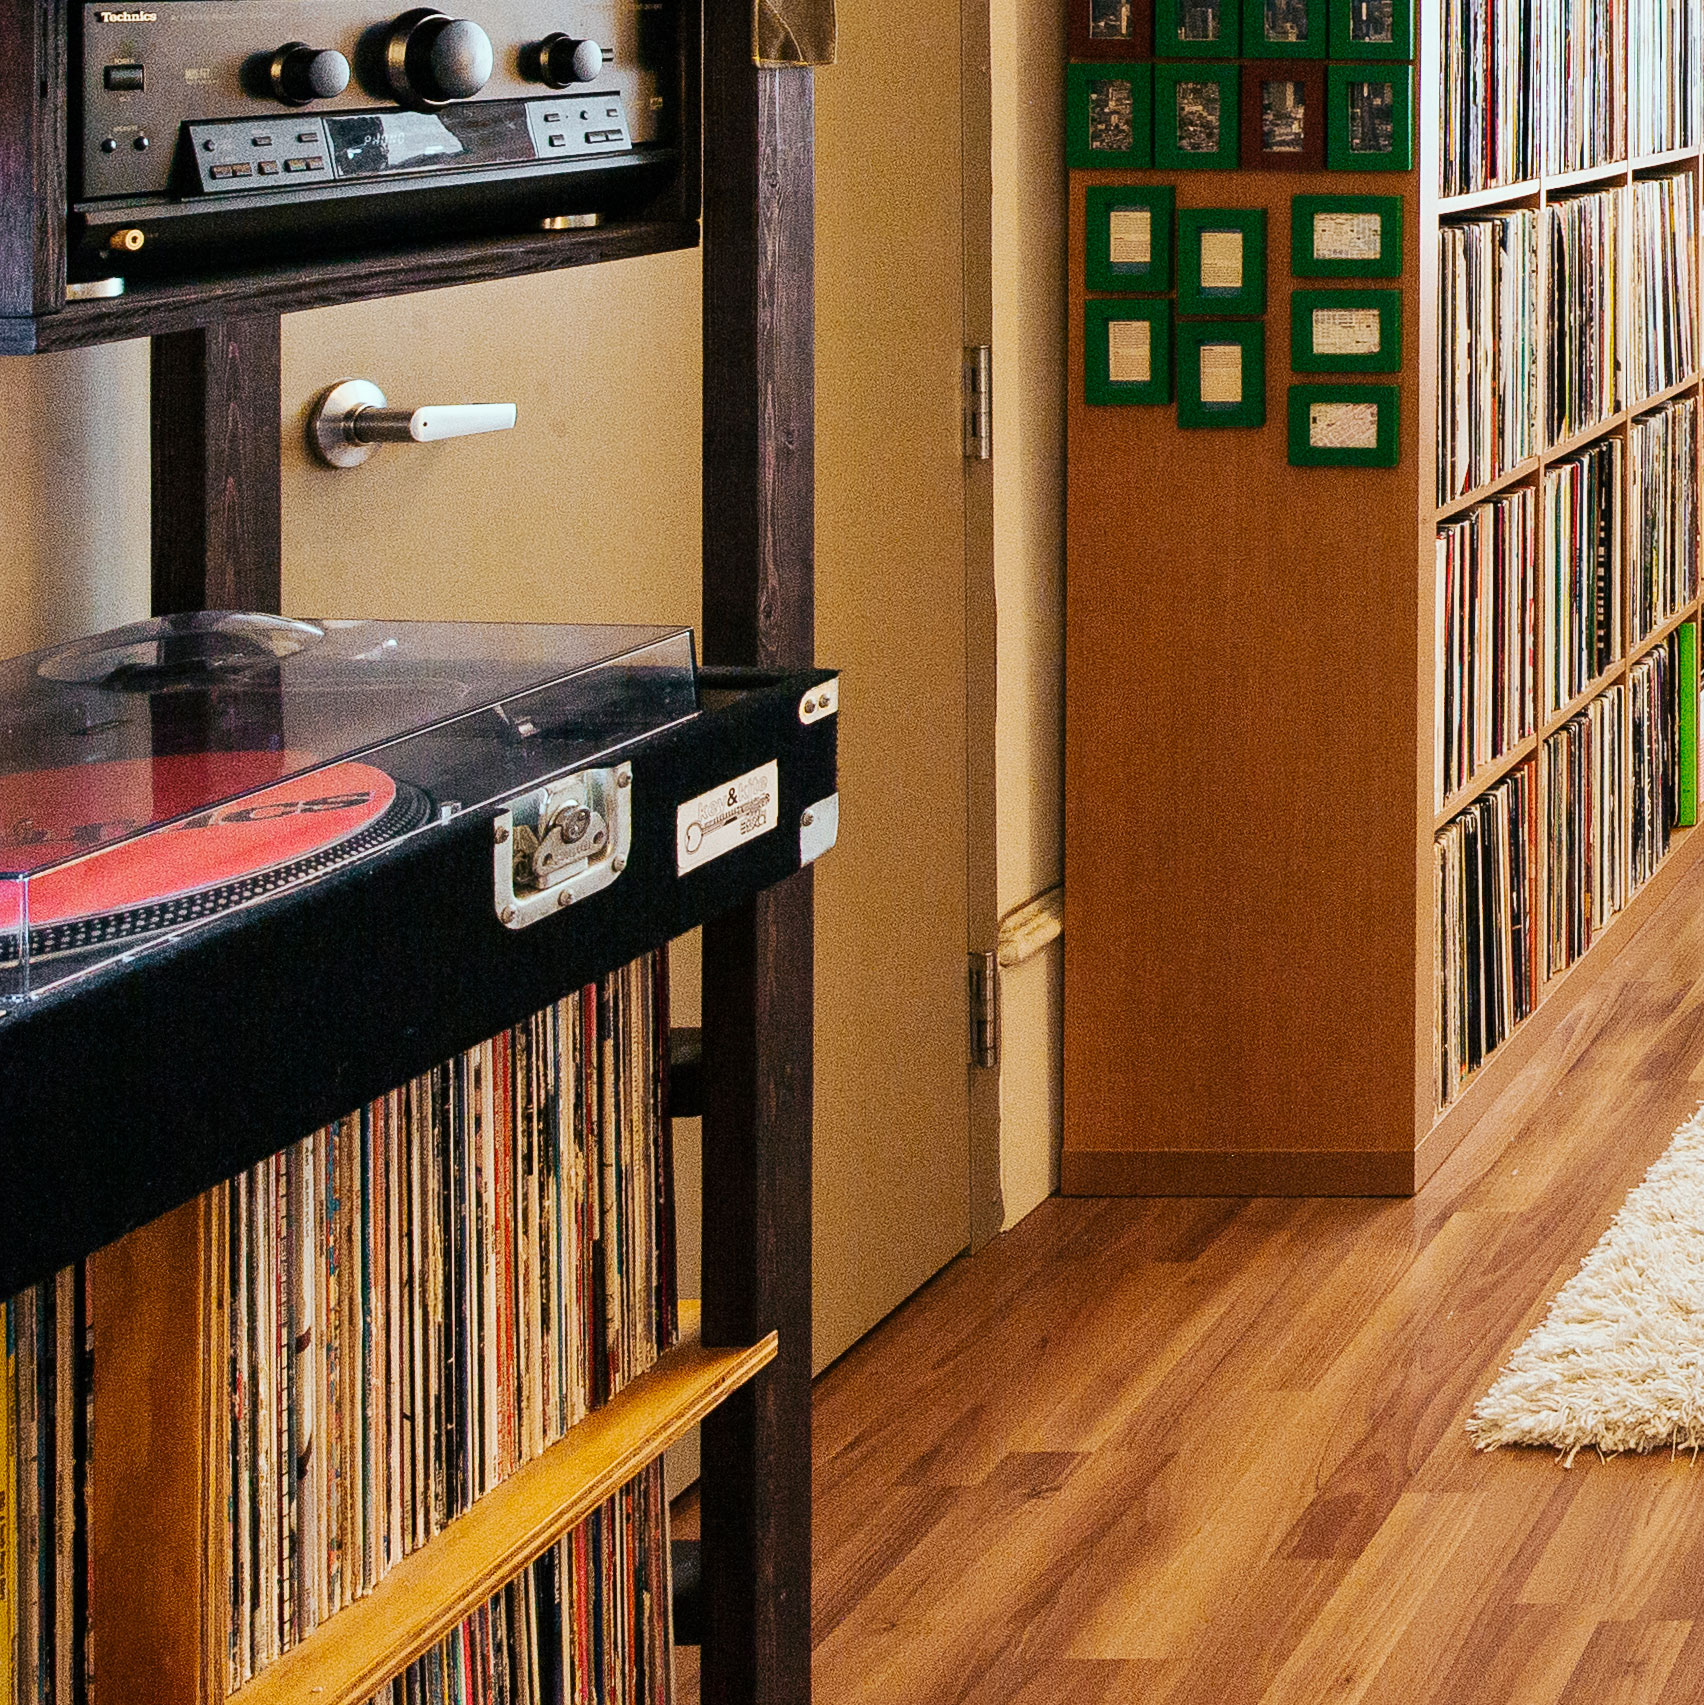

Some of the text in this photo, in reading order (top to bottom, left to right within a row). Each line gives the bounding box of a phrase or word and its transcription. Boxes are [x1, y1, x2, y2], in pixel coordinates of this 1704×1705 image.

[101, 10, 156, 23] Technics
[363, 133, 405, 146] PHONO
[727, 787, 737, 806] &
